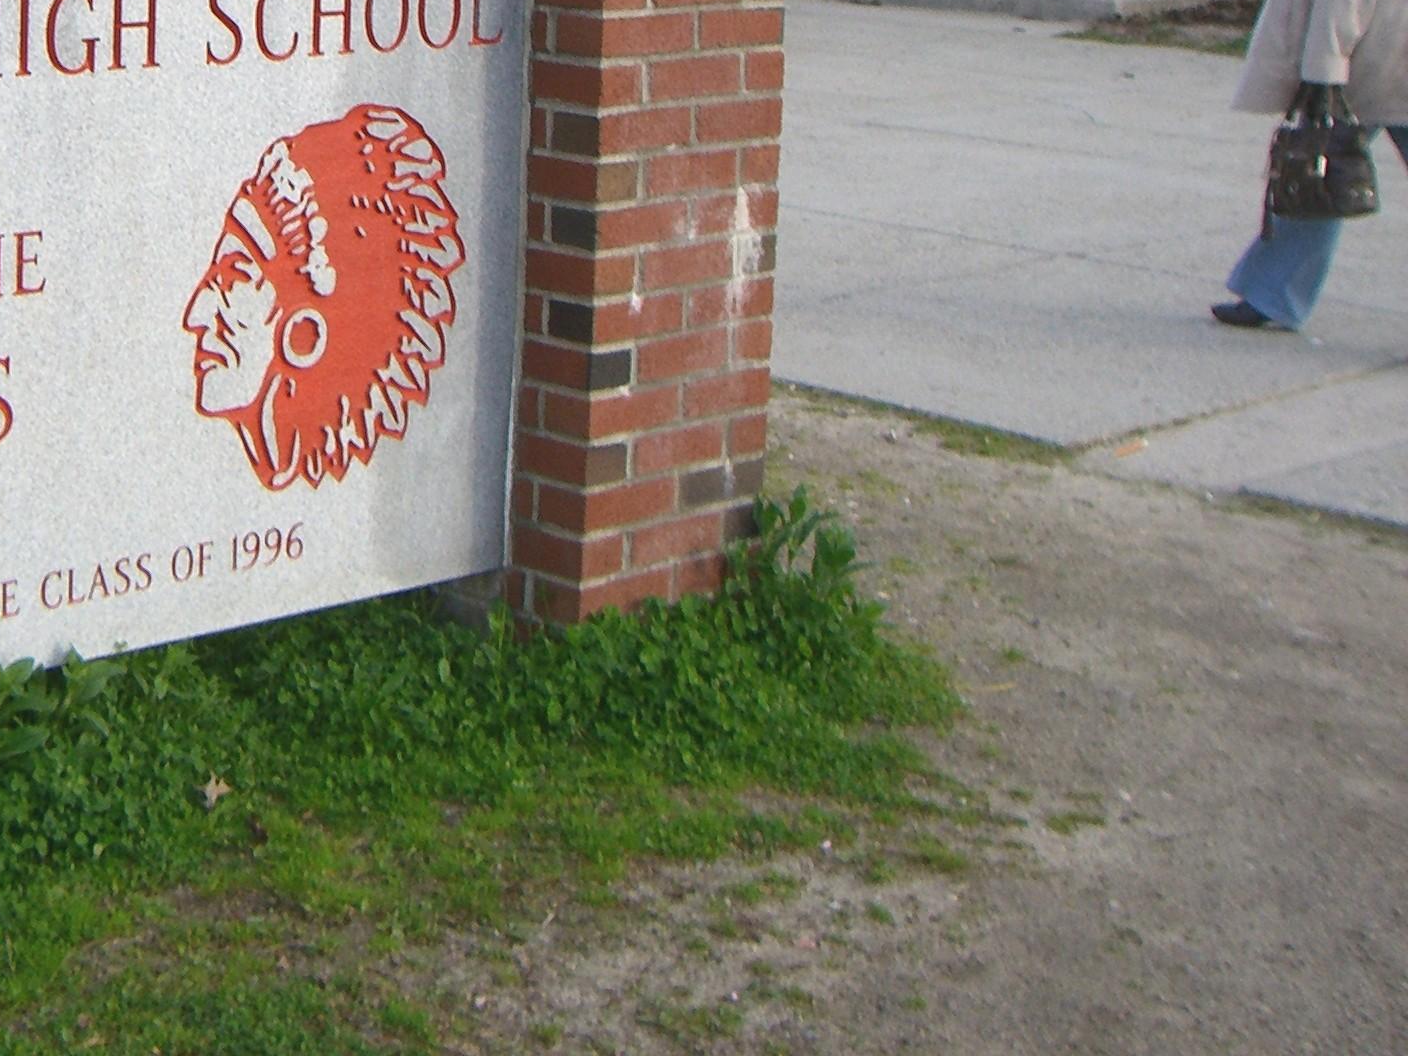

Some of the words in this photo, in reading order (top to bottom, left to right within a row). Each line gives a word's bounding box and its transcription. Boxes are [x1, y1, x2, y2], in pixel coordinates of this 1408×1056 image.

[40, 552, 153, 610] CLASS
[171, 540, 214, 583] OF
[230, 521, 305, 571] 1996
